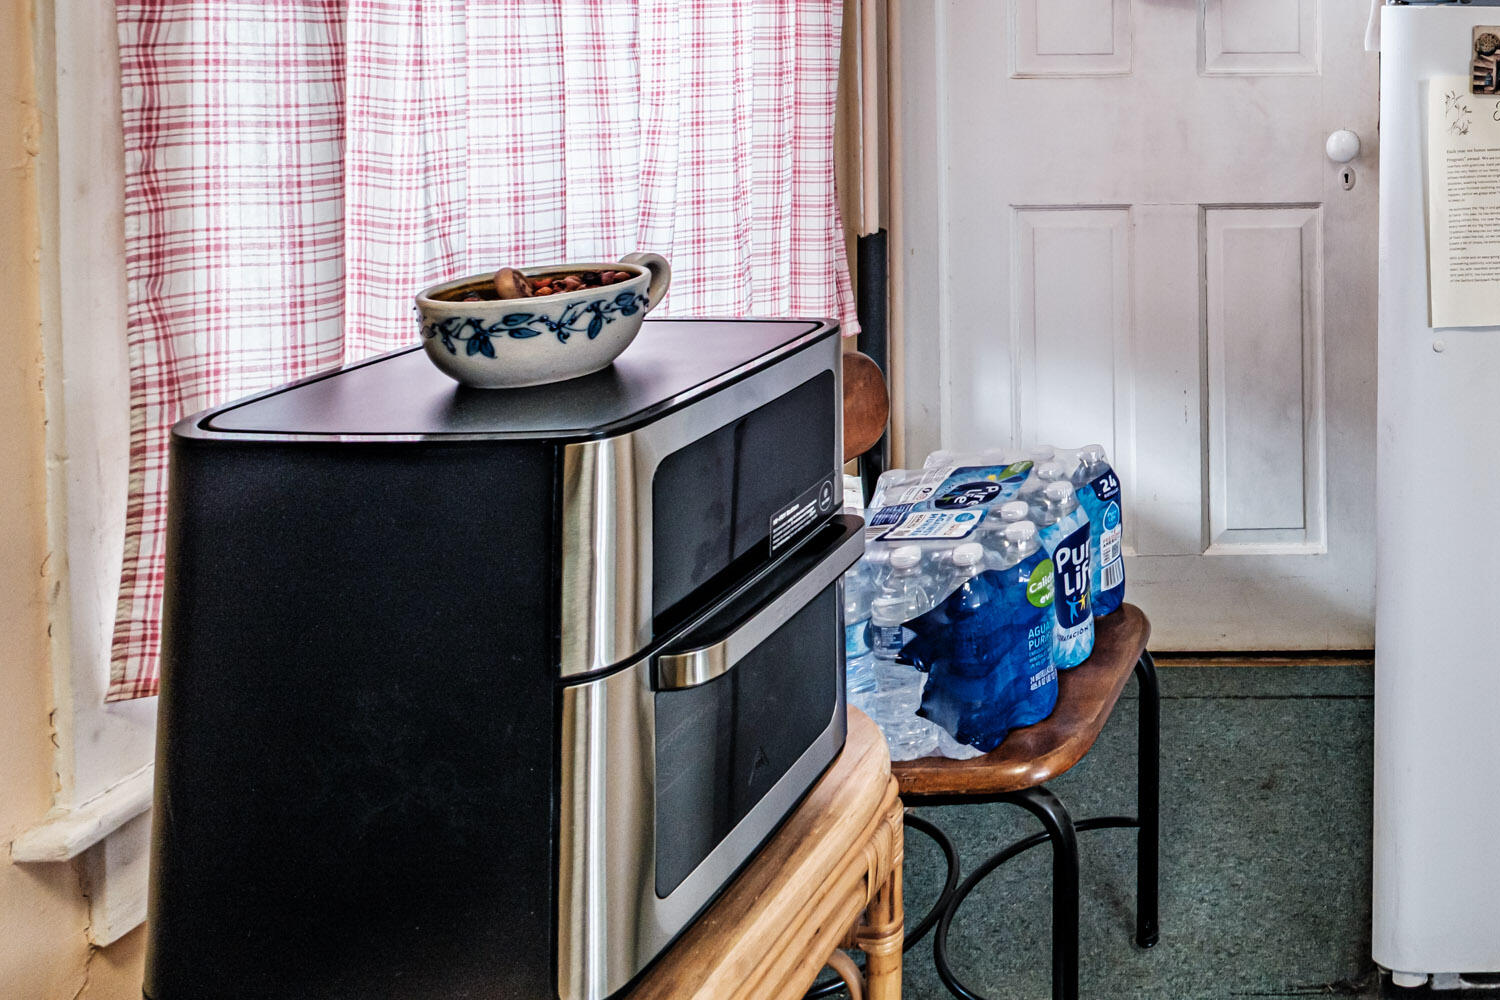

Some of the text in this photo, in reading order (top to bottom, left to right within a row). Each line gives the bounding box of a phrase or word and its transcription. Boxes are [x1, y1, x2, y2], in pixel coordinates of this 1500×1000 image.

[1100, 474, 1117, 493] 24
[1055, 538, 1090, 574] Pur
[1029, 571, 1054, 594] Calid
[1063, 559, 1091, 596] Lif
[1028, 620, 1050, 640] AGUA
